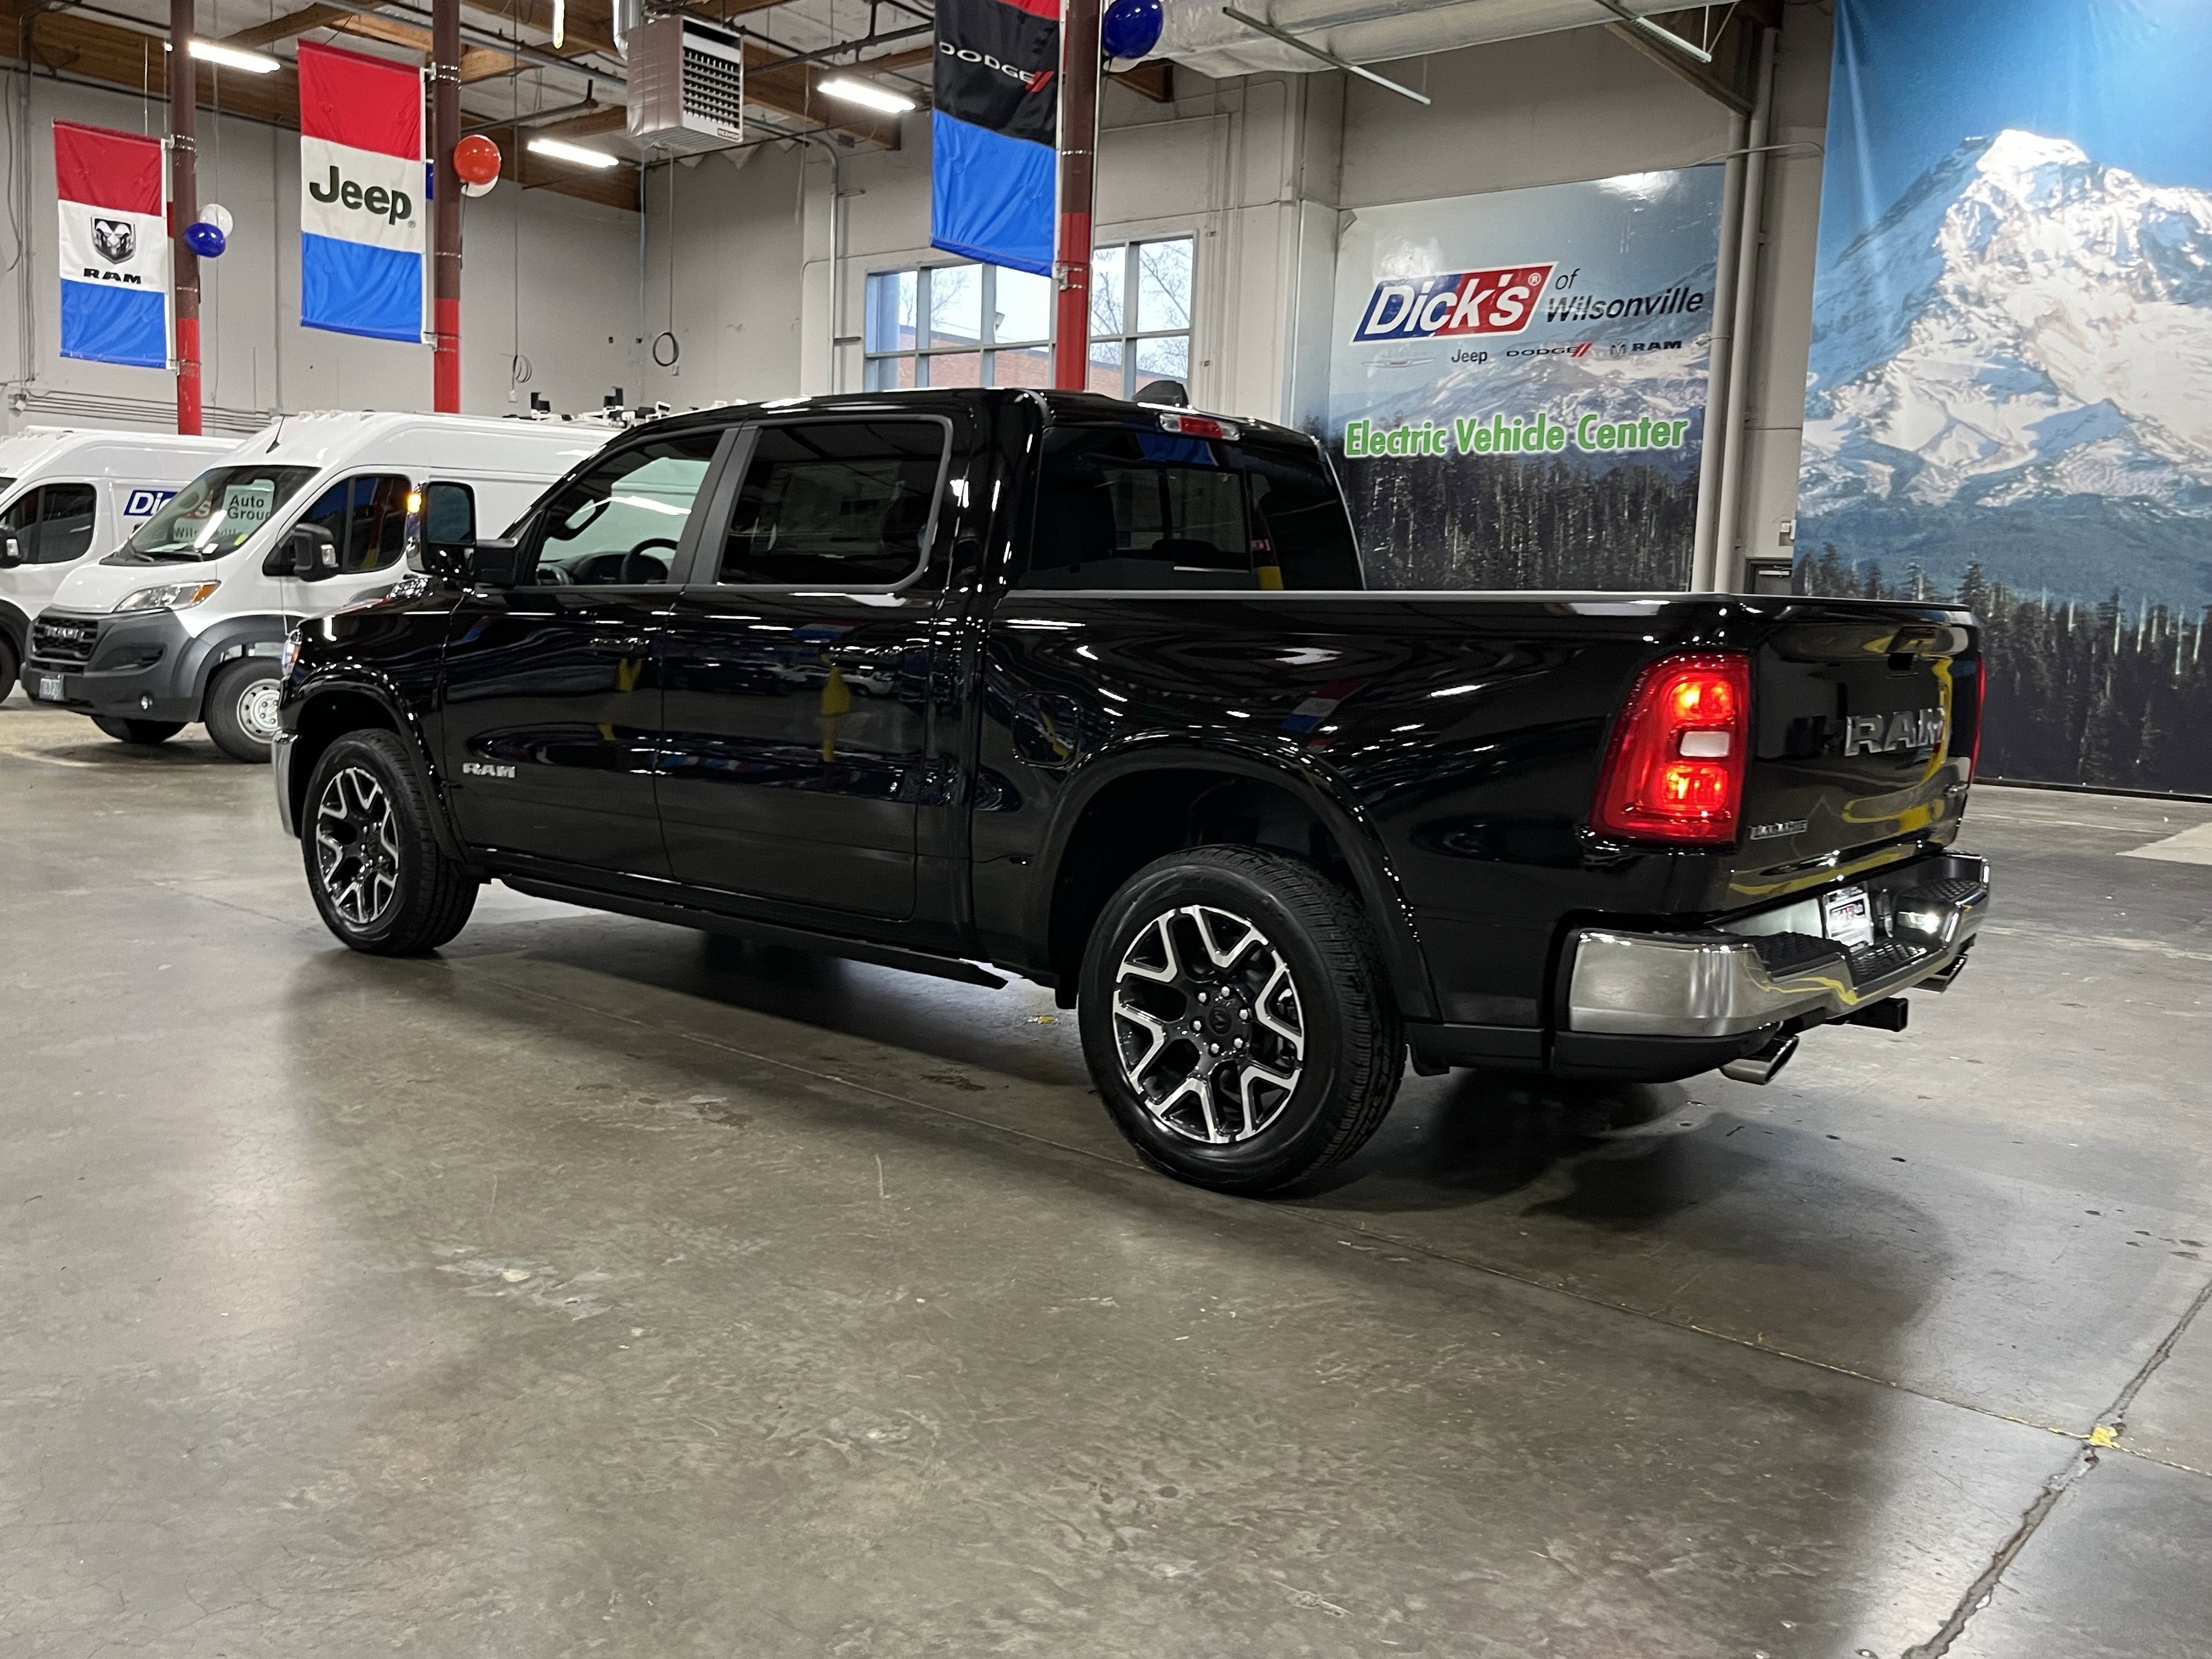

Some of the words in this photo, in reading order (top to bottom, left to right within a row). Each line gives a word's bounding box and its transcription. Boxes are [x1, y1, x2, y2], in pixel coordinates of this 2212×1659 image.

[939, 42, 1035, 84] DODGE
[309, 165, 411, 225] Jeep
[83, 268, 142, 284] RAM
[1364, 274, 1530, 335] Dick's
[1555, 268, 1581, 290] of
[1547, 287, 1703, 323] Wilsonville
[1451, 349, 1487, 364] Jeep
[1506, 346, 1578, 357] DODGE
[1632, 340, 1682, 352] RAM
[1346, 420, 1446, 455] Electric
[1456, 413, 1564, 453] Vehicle
[1578, 414, 1688, 450] Center
[230, 494, 264, 508] Auto
[1844, 708, 1946, 757] RAM
[462, 763, 515, 778] RAM
